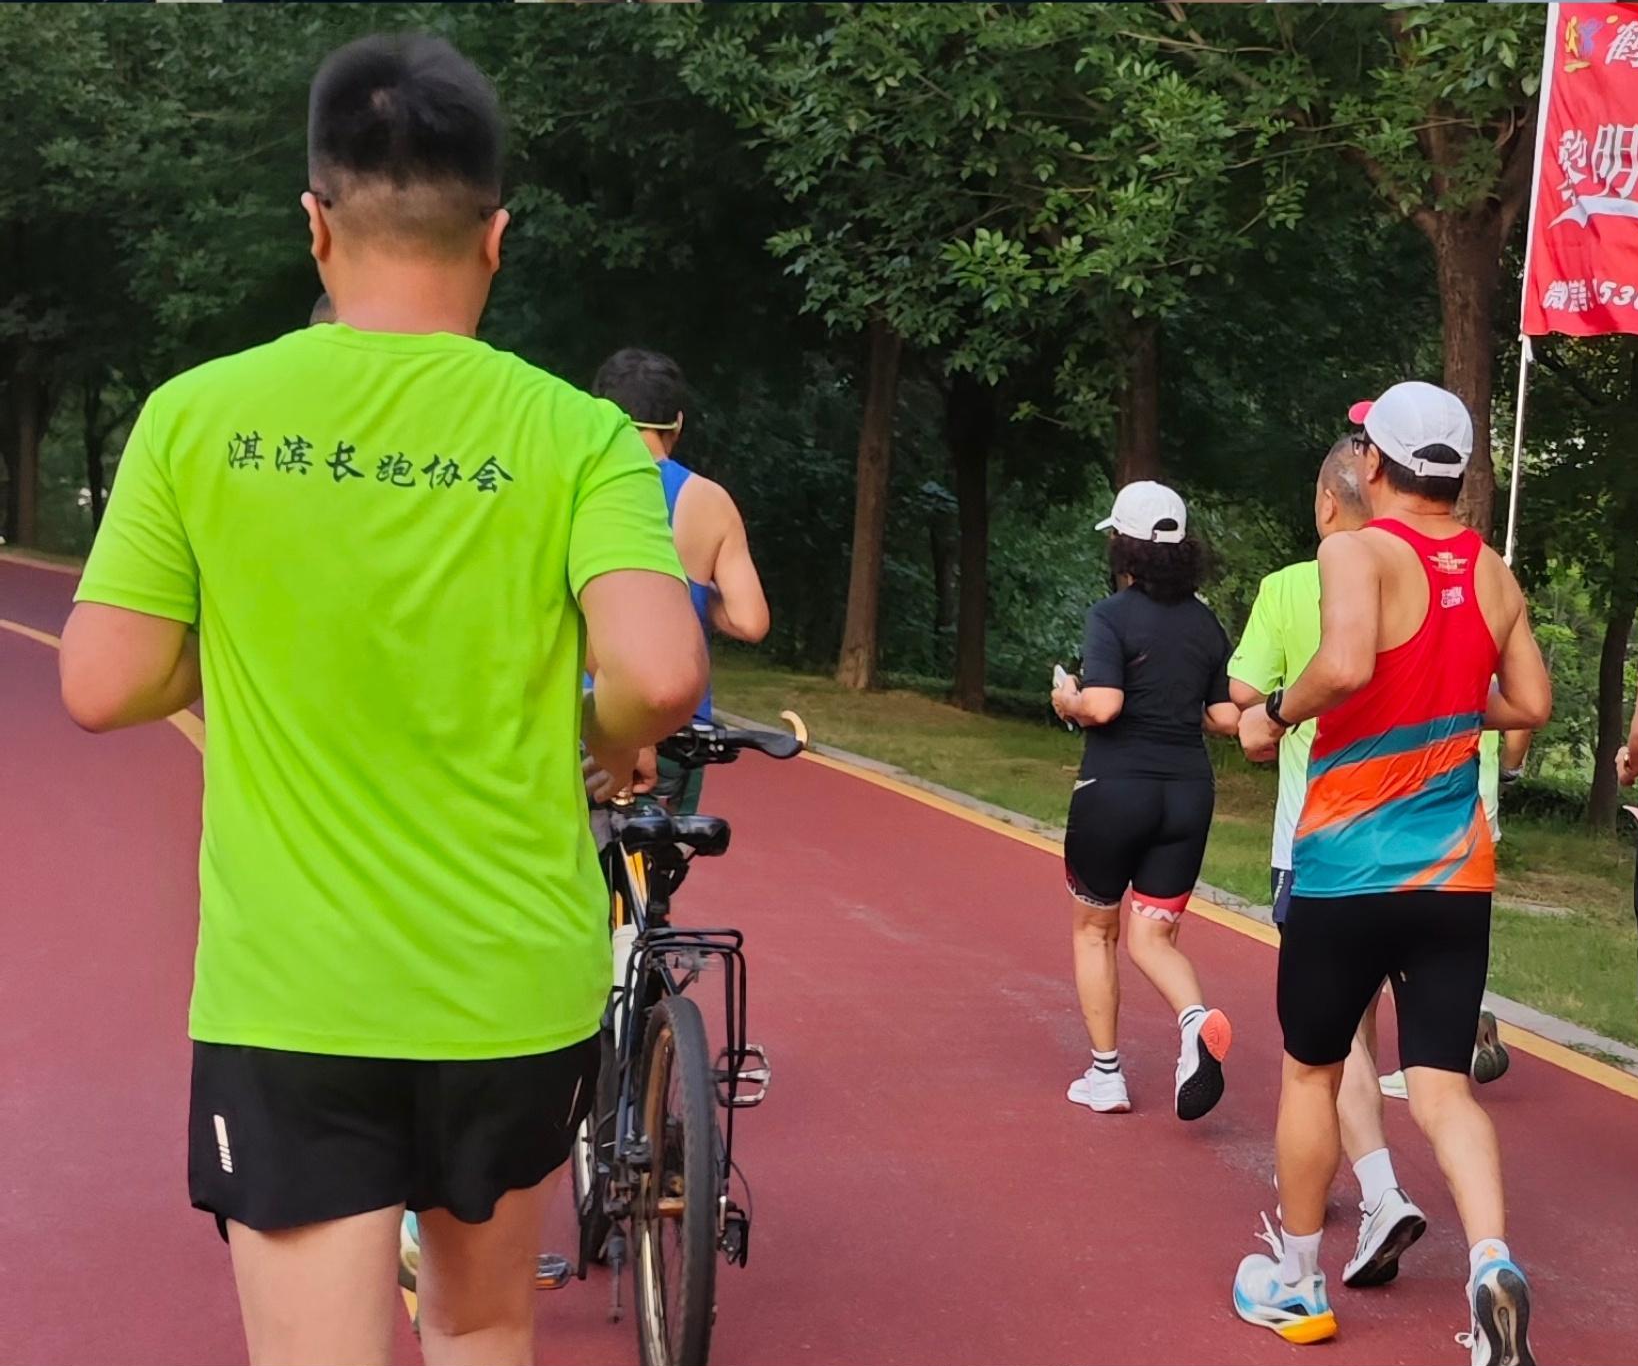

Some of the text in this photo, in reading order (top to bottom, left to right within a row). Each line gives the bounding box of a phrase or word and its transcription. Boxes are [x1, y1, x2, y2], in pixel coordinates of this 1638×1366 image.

[227, 431, 514, 494] 淇滨长跑协会
